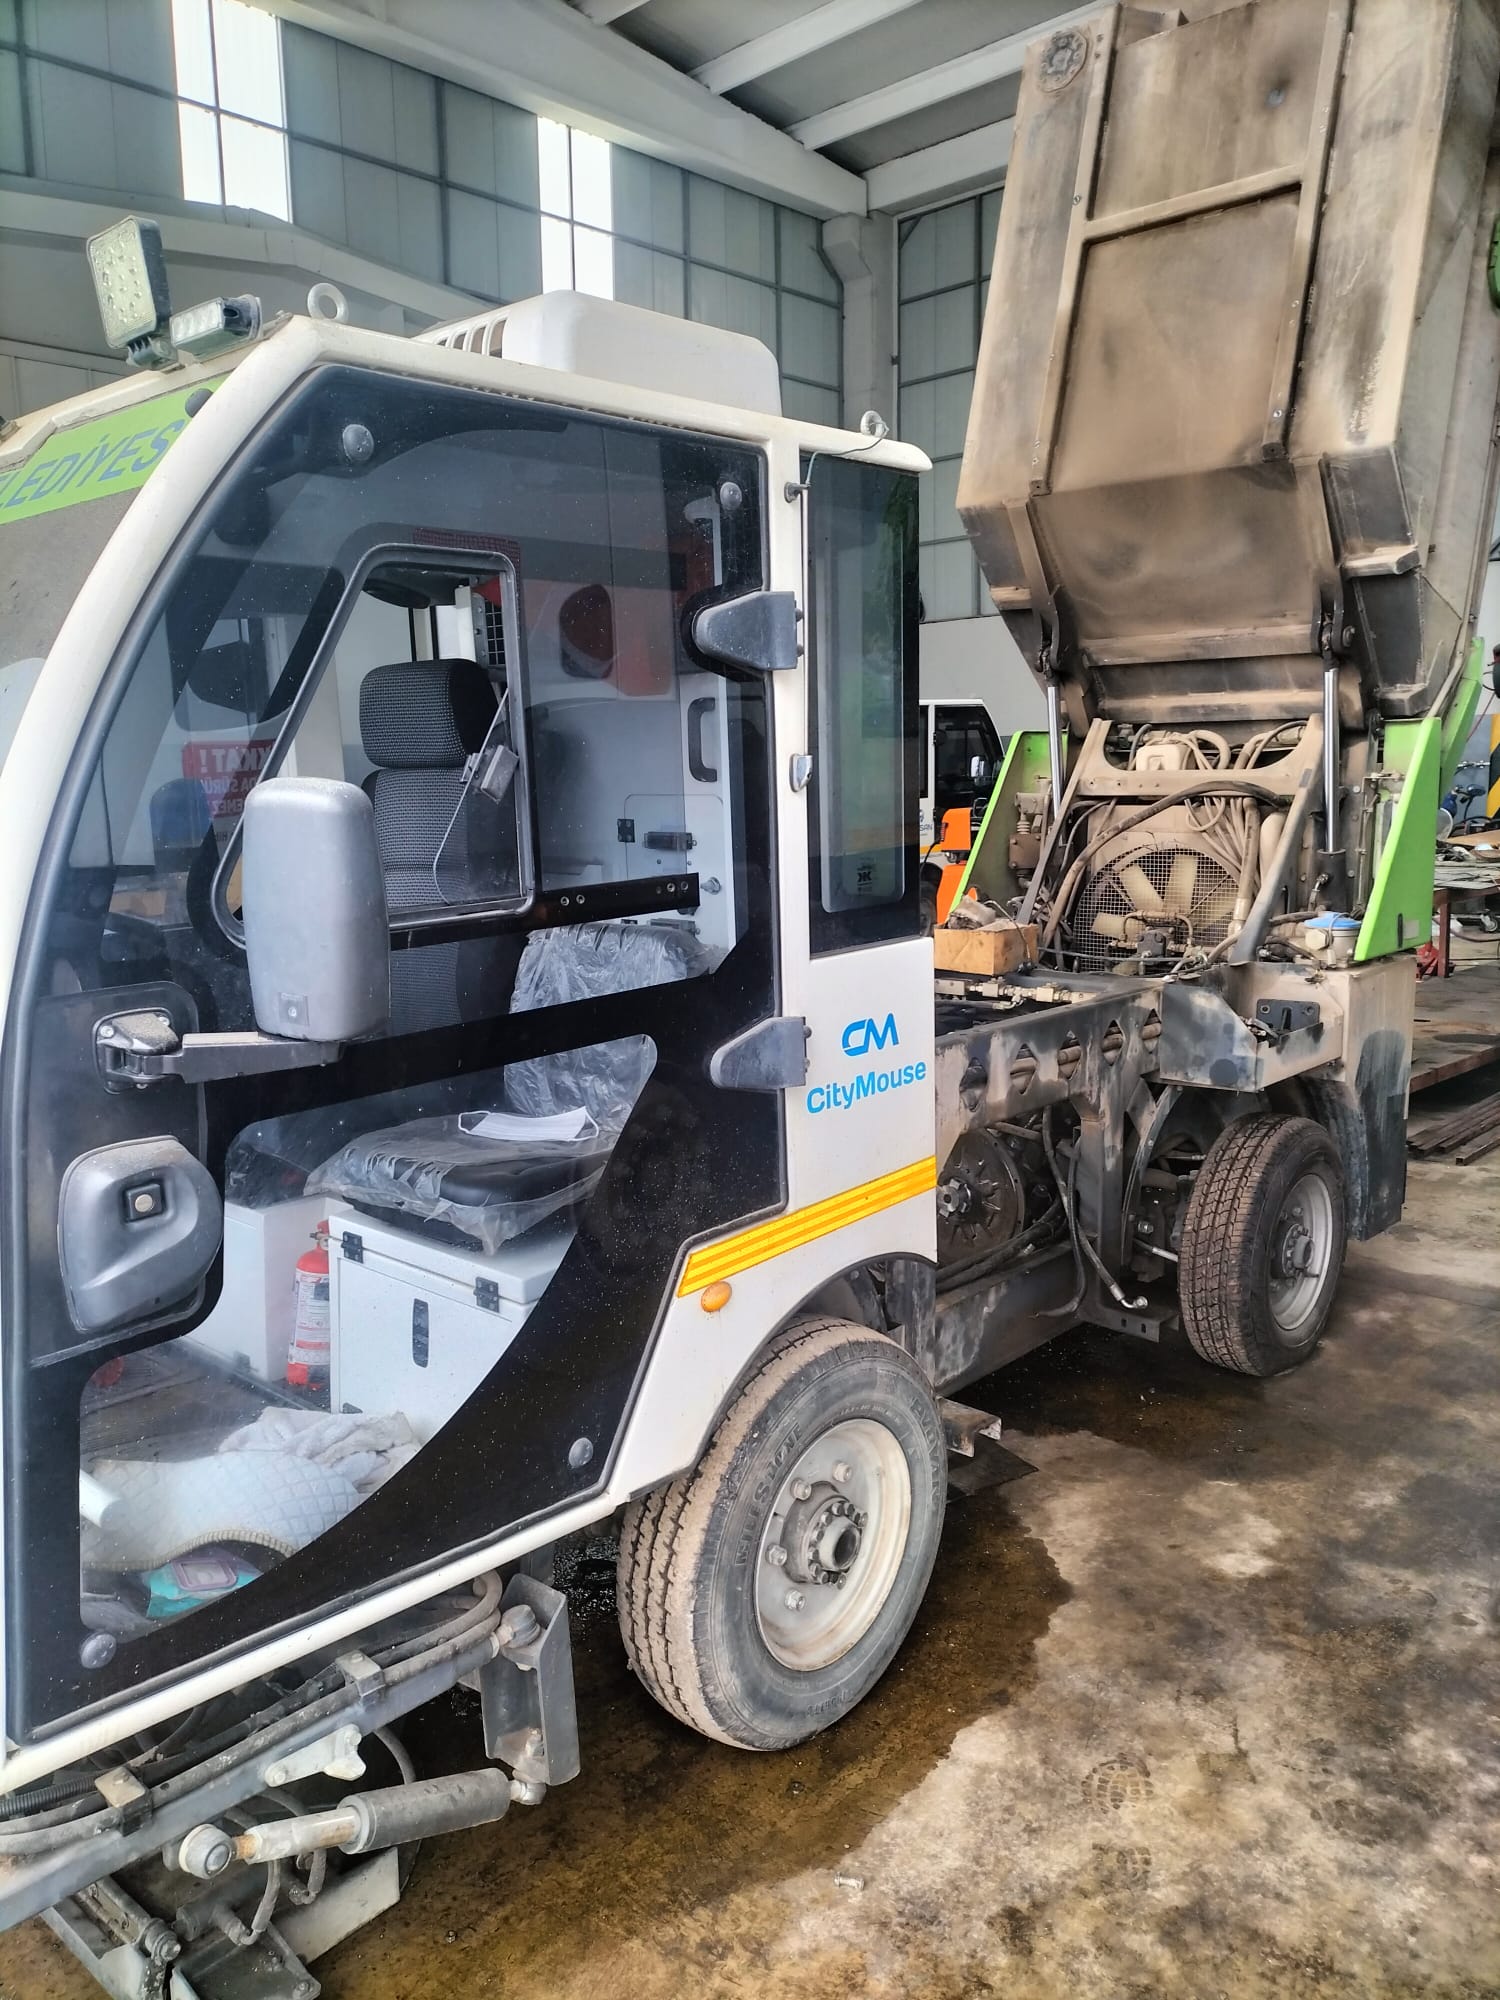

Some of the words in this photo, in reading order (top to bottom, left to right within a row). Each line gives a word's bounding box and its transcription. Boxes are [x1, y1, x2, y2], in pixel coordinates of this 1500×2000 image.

[0, 419, 186, 509] LEDİYES
[842, 1013, 899, 1057] CM
[807, 1061, 927, 1114] CityMouse
